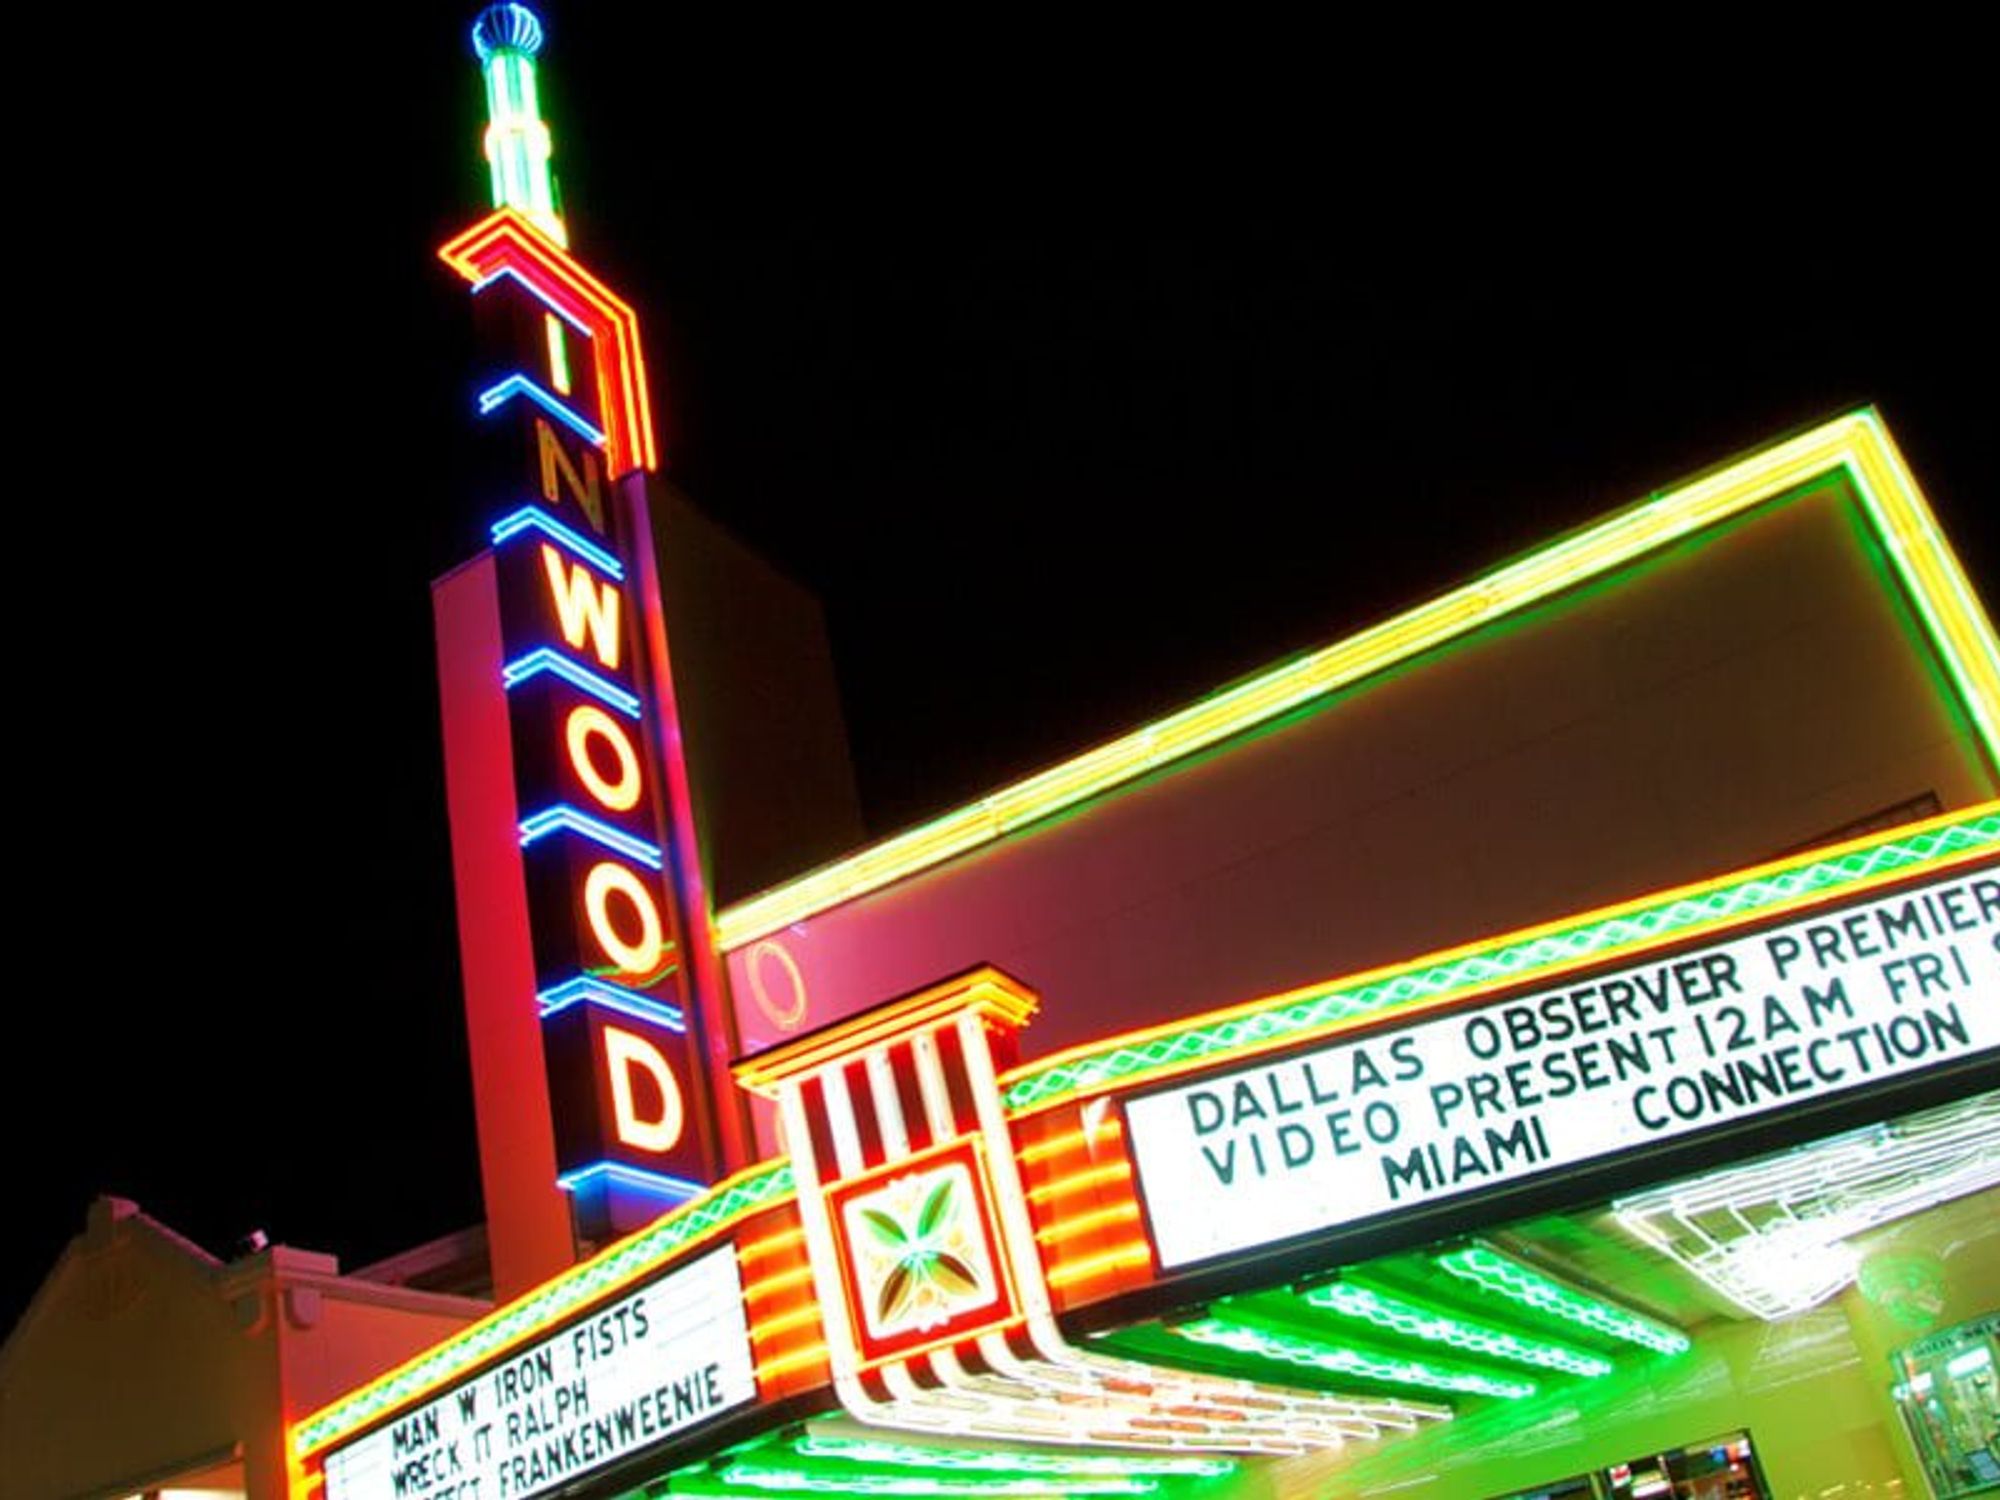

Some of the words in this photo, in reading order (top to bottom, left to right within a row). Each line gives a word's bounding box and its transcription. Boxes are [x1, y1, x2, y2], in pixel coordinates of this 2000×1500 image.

[537, 312, 684, 1152] INWOOD
[1187, 1037, 1424, 1135] DALLAS
[1464, 953, 1742, 1059] OBSERVER
[1202, 1101, 1400, 1185] VIDEO
[1430, 1027, 1676, 1128] PRESENT
[1694, 978, 1854, 1057] 12AM
[1881, 945, 1971, 1004] FRI
[1381, 1116, 1550, 1199] MIAMI
[1632, 1002, 1970, 1130] CONNECTION
[390, 1441, 463, 1497] WRECK
[474, 1423, 493, 1462] IT
[507, 1378, 588, 1448] RALPH
[393, 1407, 439, 1460] MAN
[457, 1386, 477, 1423] W
[495, 1347, 553, 1408] IRON
[574, 1298, 649, 1369] FISTS
[500, 1364, 723, 1498] FRANKENWEENIE
